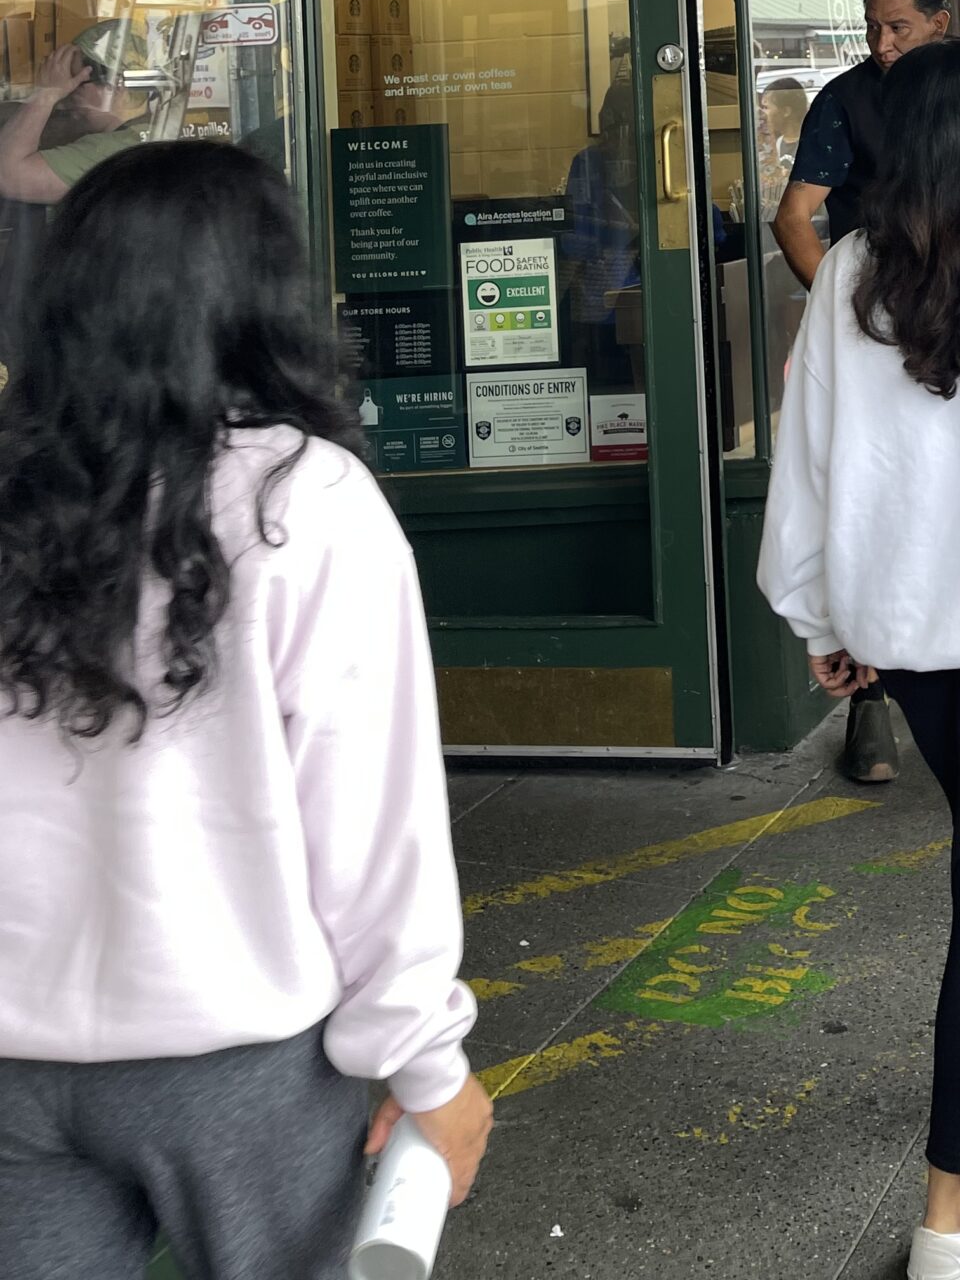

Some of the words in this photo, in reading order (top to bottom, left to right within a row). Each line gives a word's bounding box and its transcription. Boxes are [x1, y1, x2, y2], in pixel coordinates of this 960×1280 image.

[384, 75, 400, 85] We
[403, 74, 428, 84] roast
[432, 73, 449, 82] our
[453, 72, 475, 80] own
[478, 69, 516, 79] coffees
[385, 87, 404, 97] and
[406, 85, 440, 97] import
[444, 84, 460, 93] our
[465, 82, 487, 91] own
[490, 81, 512, 90] teas
[348, 140, 408, 151] WELCOME
[349, 162, 364, 171] Join
[384, 160, 416, 168] creating
[354, 173, 376, 182] joyful
[378, 172, 392, 180] and
[394, 171, 428, 179] inclusive
[349, 187, 371, 195] space
[373, 184, 396, 192] where
[350, 197, 370, 207] uplift
[387, 195, 418, 204] another
[368, 209, 393, 217] coffee.
[521, 209, 551, 217] location
[350, 228, 376, 236] Thank
[377, 228, 390, 236] you
[351, 240, 373, 250] being
[380, 239, 395, 248] part
[396, 238, 405, 246] of
[352, 252, 398, 261] community.
[466, 258, 515, 274] FOOD
[506, 286, 545, 297] EXCELLENT
[476, 383, 530, 397] CONDITIONS
[533, 382, 544, 394] OF
[548, 381, 576, 394] ENTRY
[396, 393, 421, 403] WE'RE
[424, 392, 453, 401] HIRING
